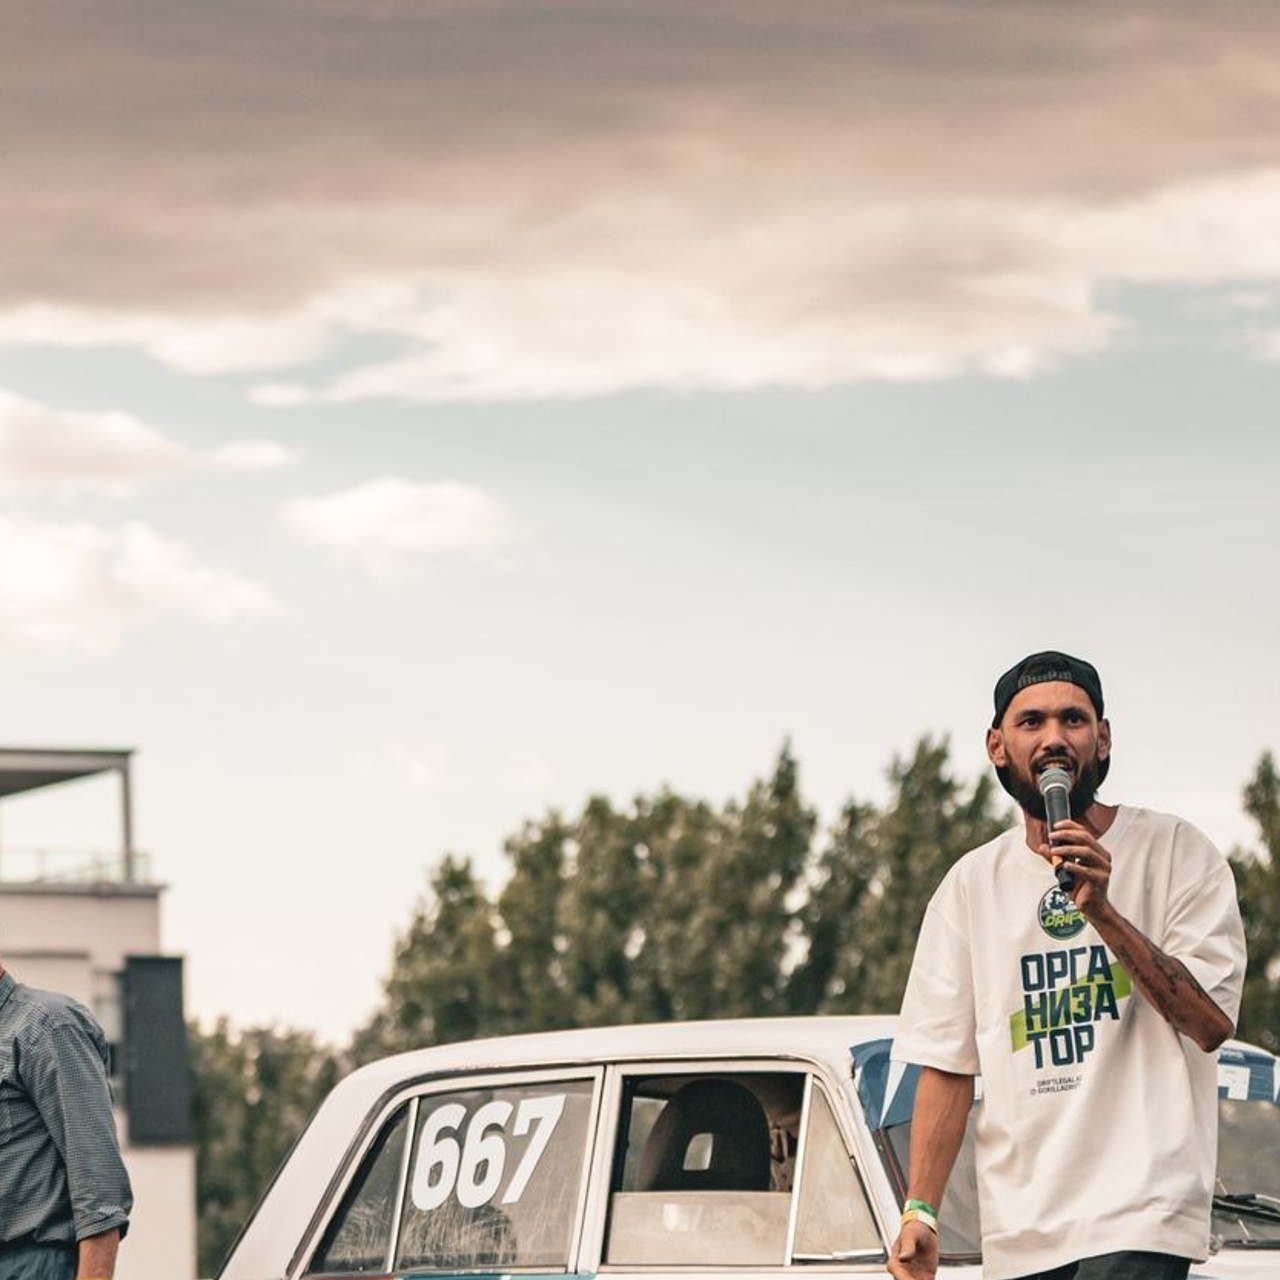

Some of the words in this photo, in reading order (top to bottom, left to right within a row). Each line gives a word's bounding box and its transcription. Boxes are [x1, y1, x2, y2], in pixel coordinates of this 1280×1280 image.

[1021, 945, 1114, 992] ОРГА
[1024, 983, 1121, 1031] НИЗА
[1026, 1024, 1095, 1070] ТОР
[412, 1094, 568, 1211] 667
